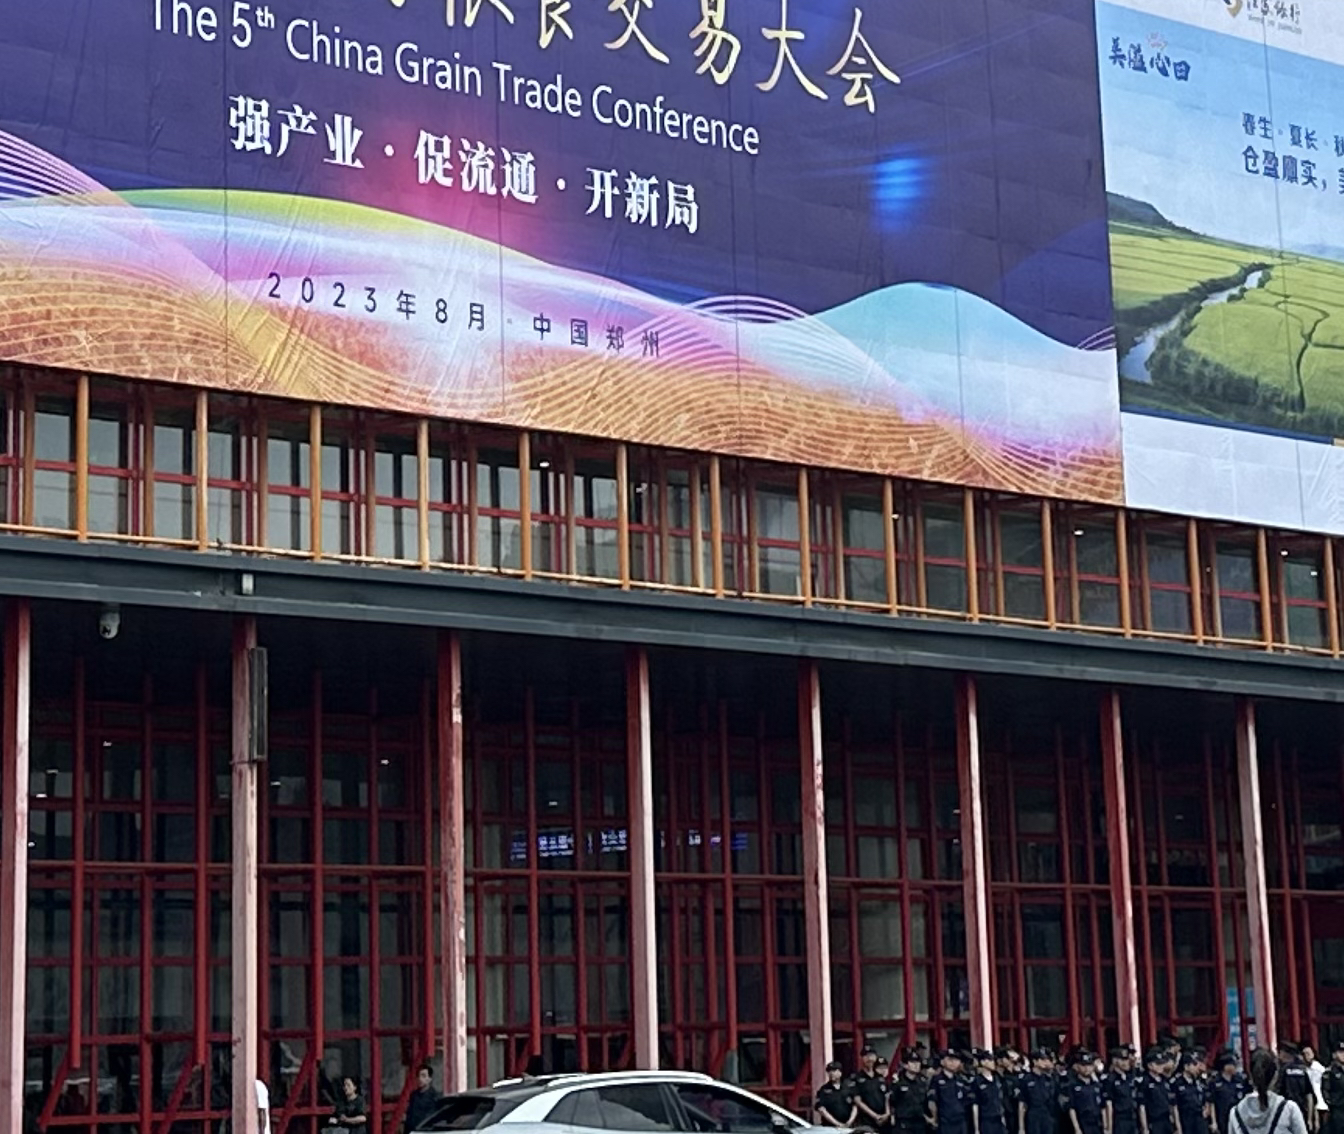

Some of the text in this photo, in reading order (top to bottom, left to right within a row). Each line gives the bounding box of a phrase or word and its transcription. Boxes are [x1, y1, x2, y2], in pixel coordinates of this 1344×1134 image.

[232, 1, 275, 49] 5th
[285, 18, 384, 76] China
[395, 41, 482, 97] Grain
[492, 62, 582, 118] Trade
[592, 86, 760, 156] Conference
[1108, 36, 1191, 81] 美溢心田
[229, 94, 700, 234] 强产业·促流通·开新局
